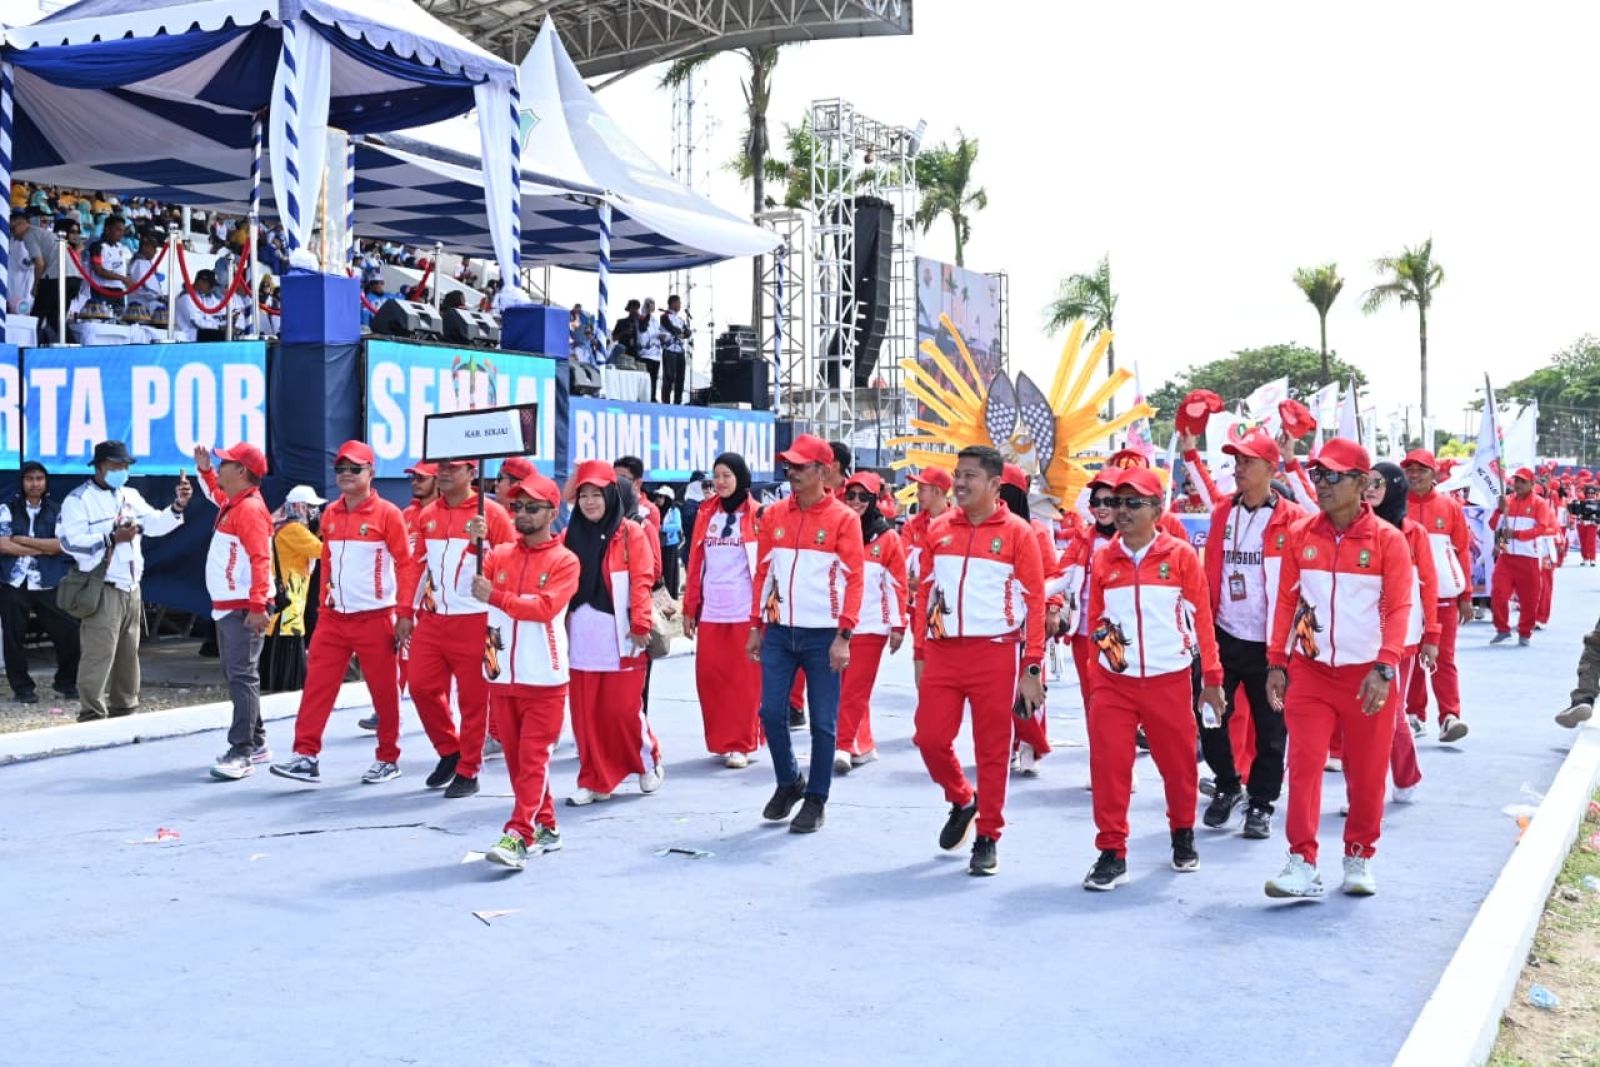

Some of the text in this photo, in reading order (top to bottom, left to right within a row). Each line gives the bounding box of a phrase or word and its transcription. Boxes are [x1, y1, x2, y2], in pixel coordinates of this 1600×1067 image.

[131, 362, 266, 457] POR
[575, 409, 650, 470] BUMI
[724, 420, 776, 473] MALI
